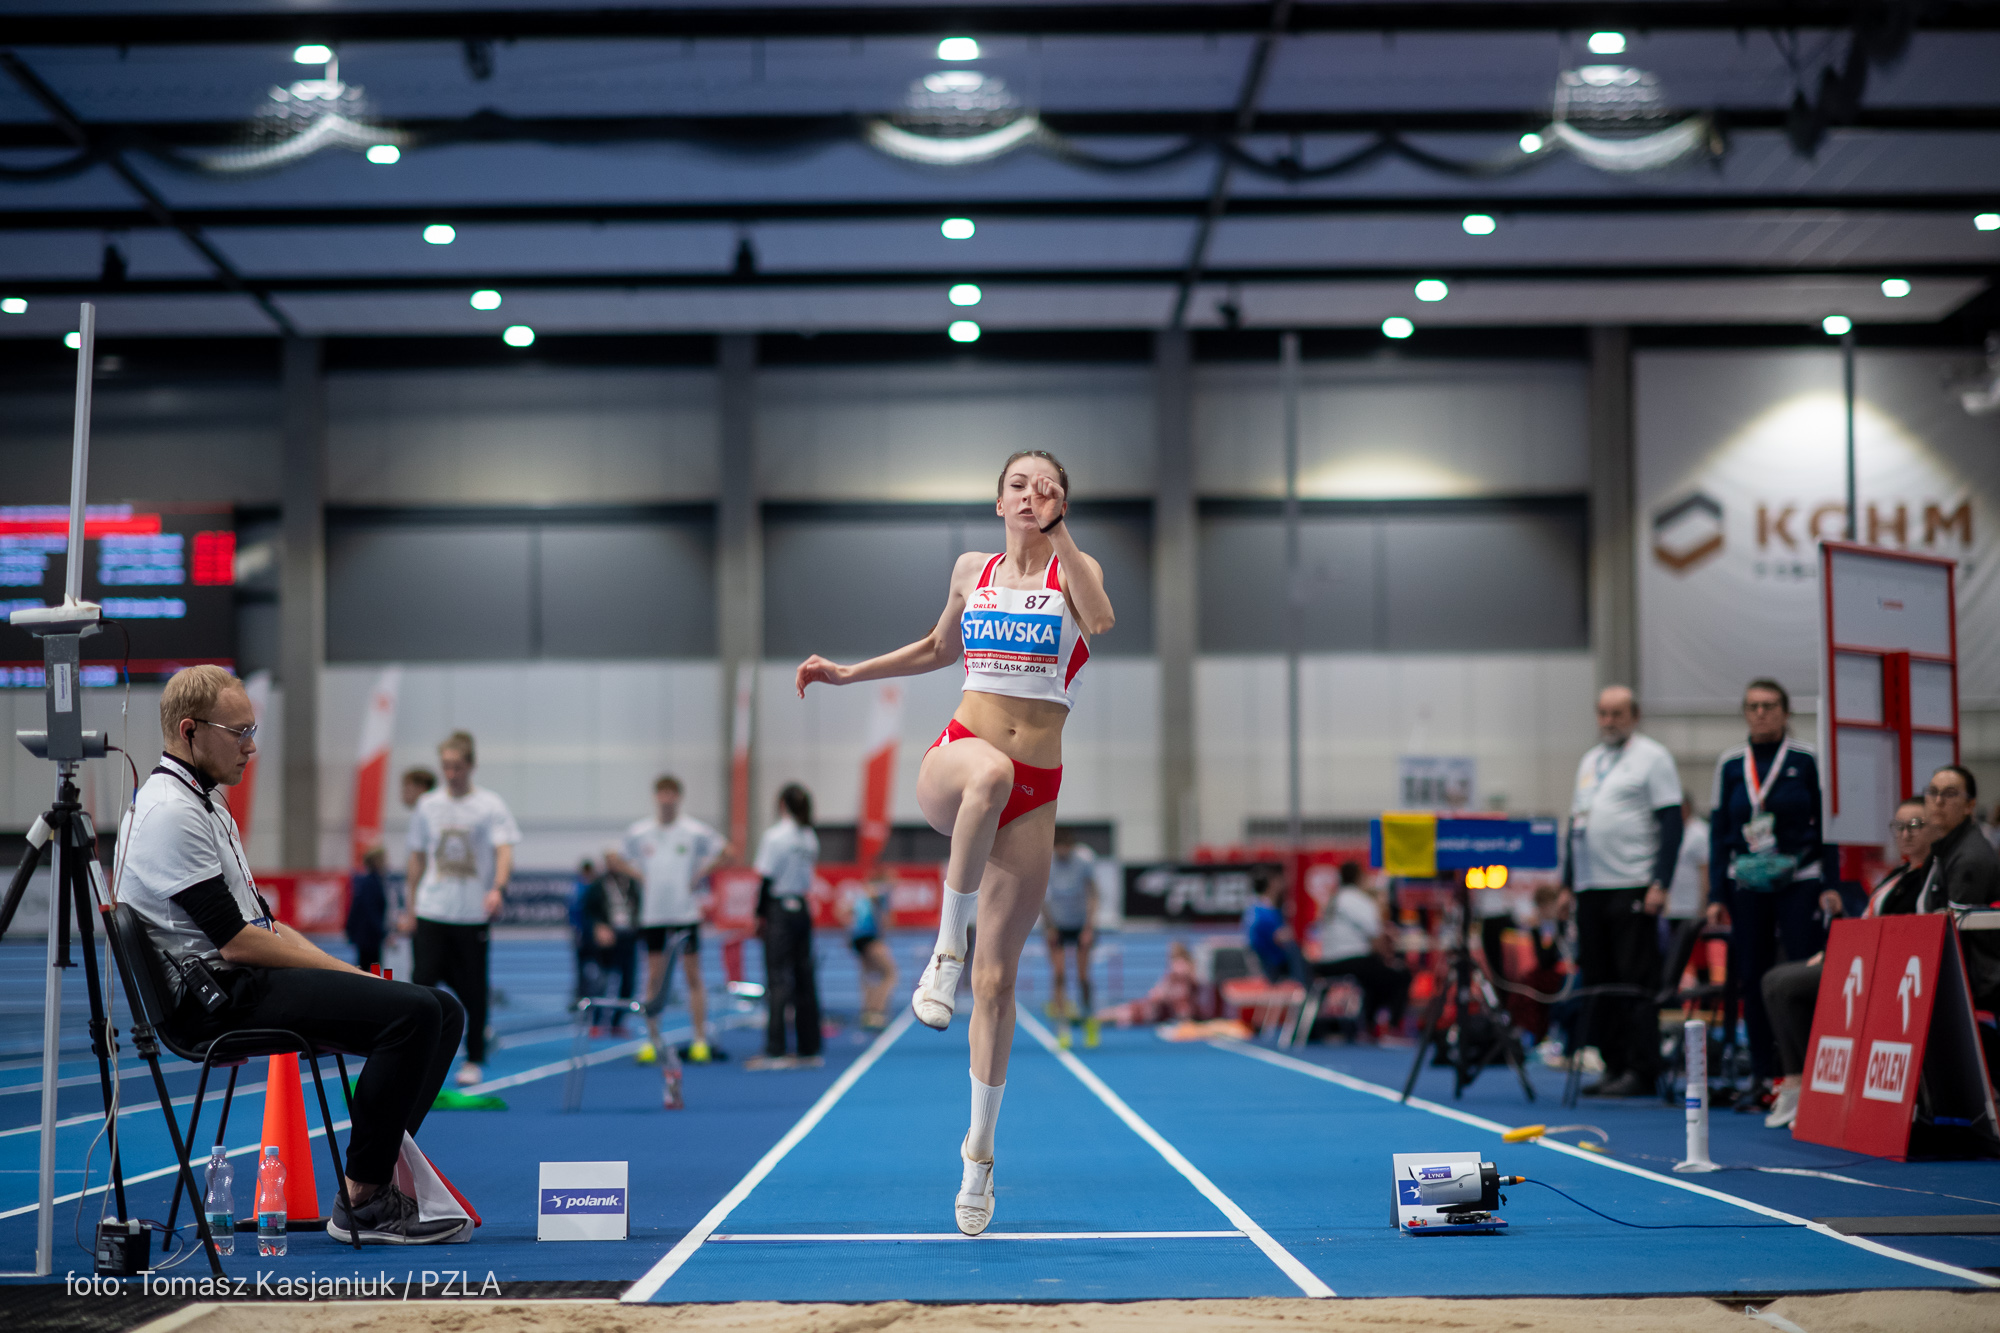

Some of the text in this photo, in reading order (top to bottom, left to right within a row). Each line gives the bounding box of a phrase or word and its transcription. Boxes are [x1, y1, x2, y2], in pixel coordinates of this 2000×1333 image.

[1024, 595, 1051, 610] 87
[963, 620, 1055, 645] STAWSKA
[987, 652, 1017, 660] Mistrzostwa
[972, 660, 1047, 673] DONY ŚLĄSK 2024
[1816, 1046, 1849, 1083] ORLEN
[1867, 1050, 1908, 1092] ORLEN
[565, 1194, 620, 1209] polanik
